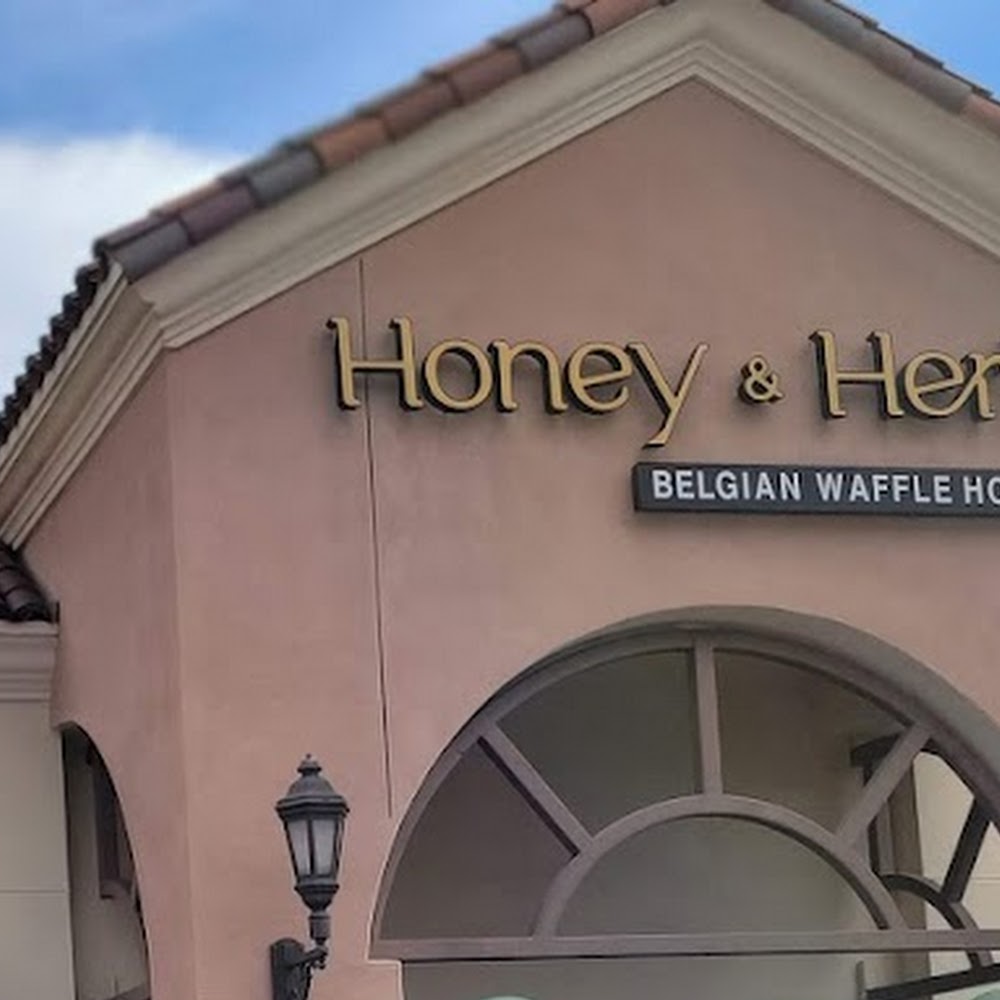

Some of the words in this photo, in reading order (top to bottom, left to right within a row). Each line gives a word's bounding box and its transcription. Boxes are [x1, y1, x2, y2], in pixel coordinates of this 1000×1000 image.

[326, 316, 708, 449] Honey
[738, 355, 784, 404] &
[652, 469, 801, 501] BELGIAN
[816, 472, 953, 504] WAFFLE
